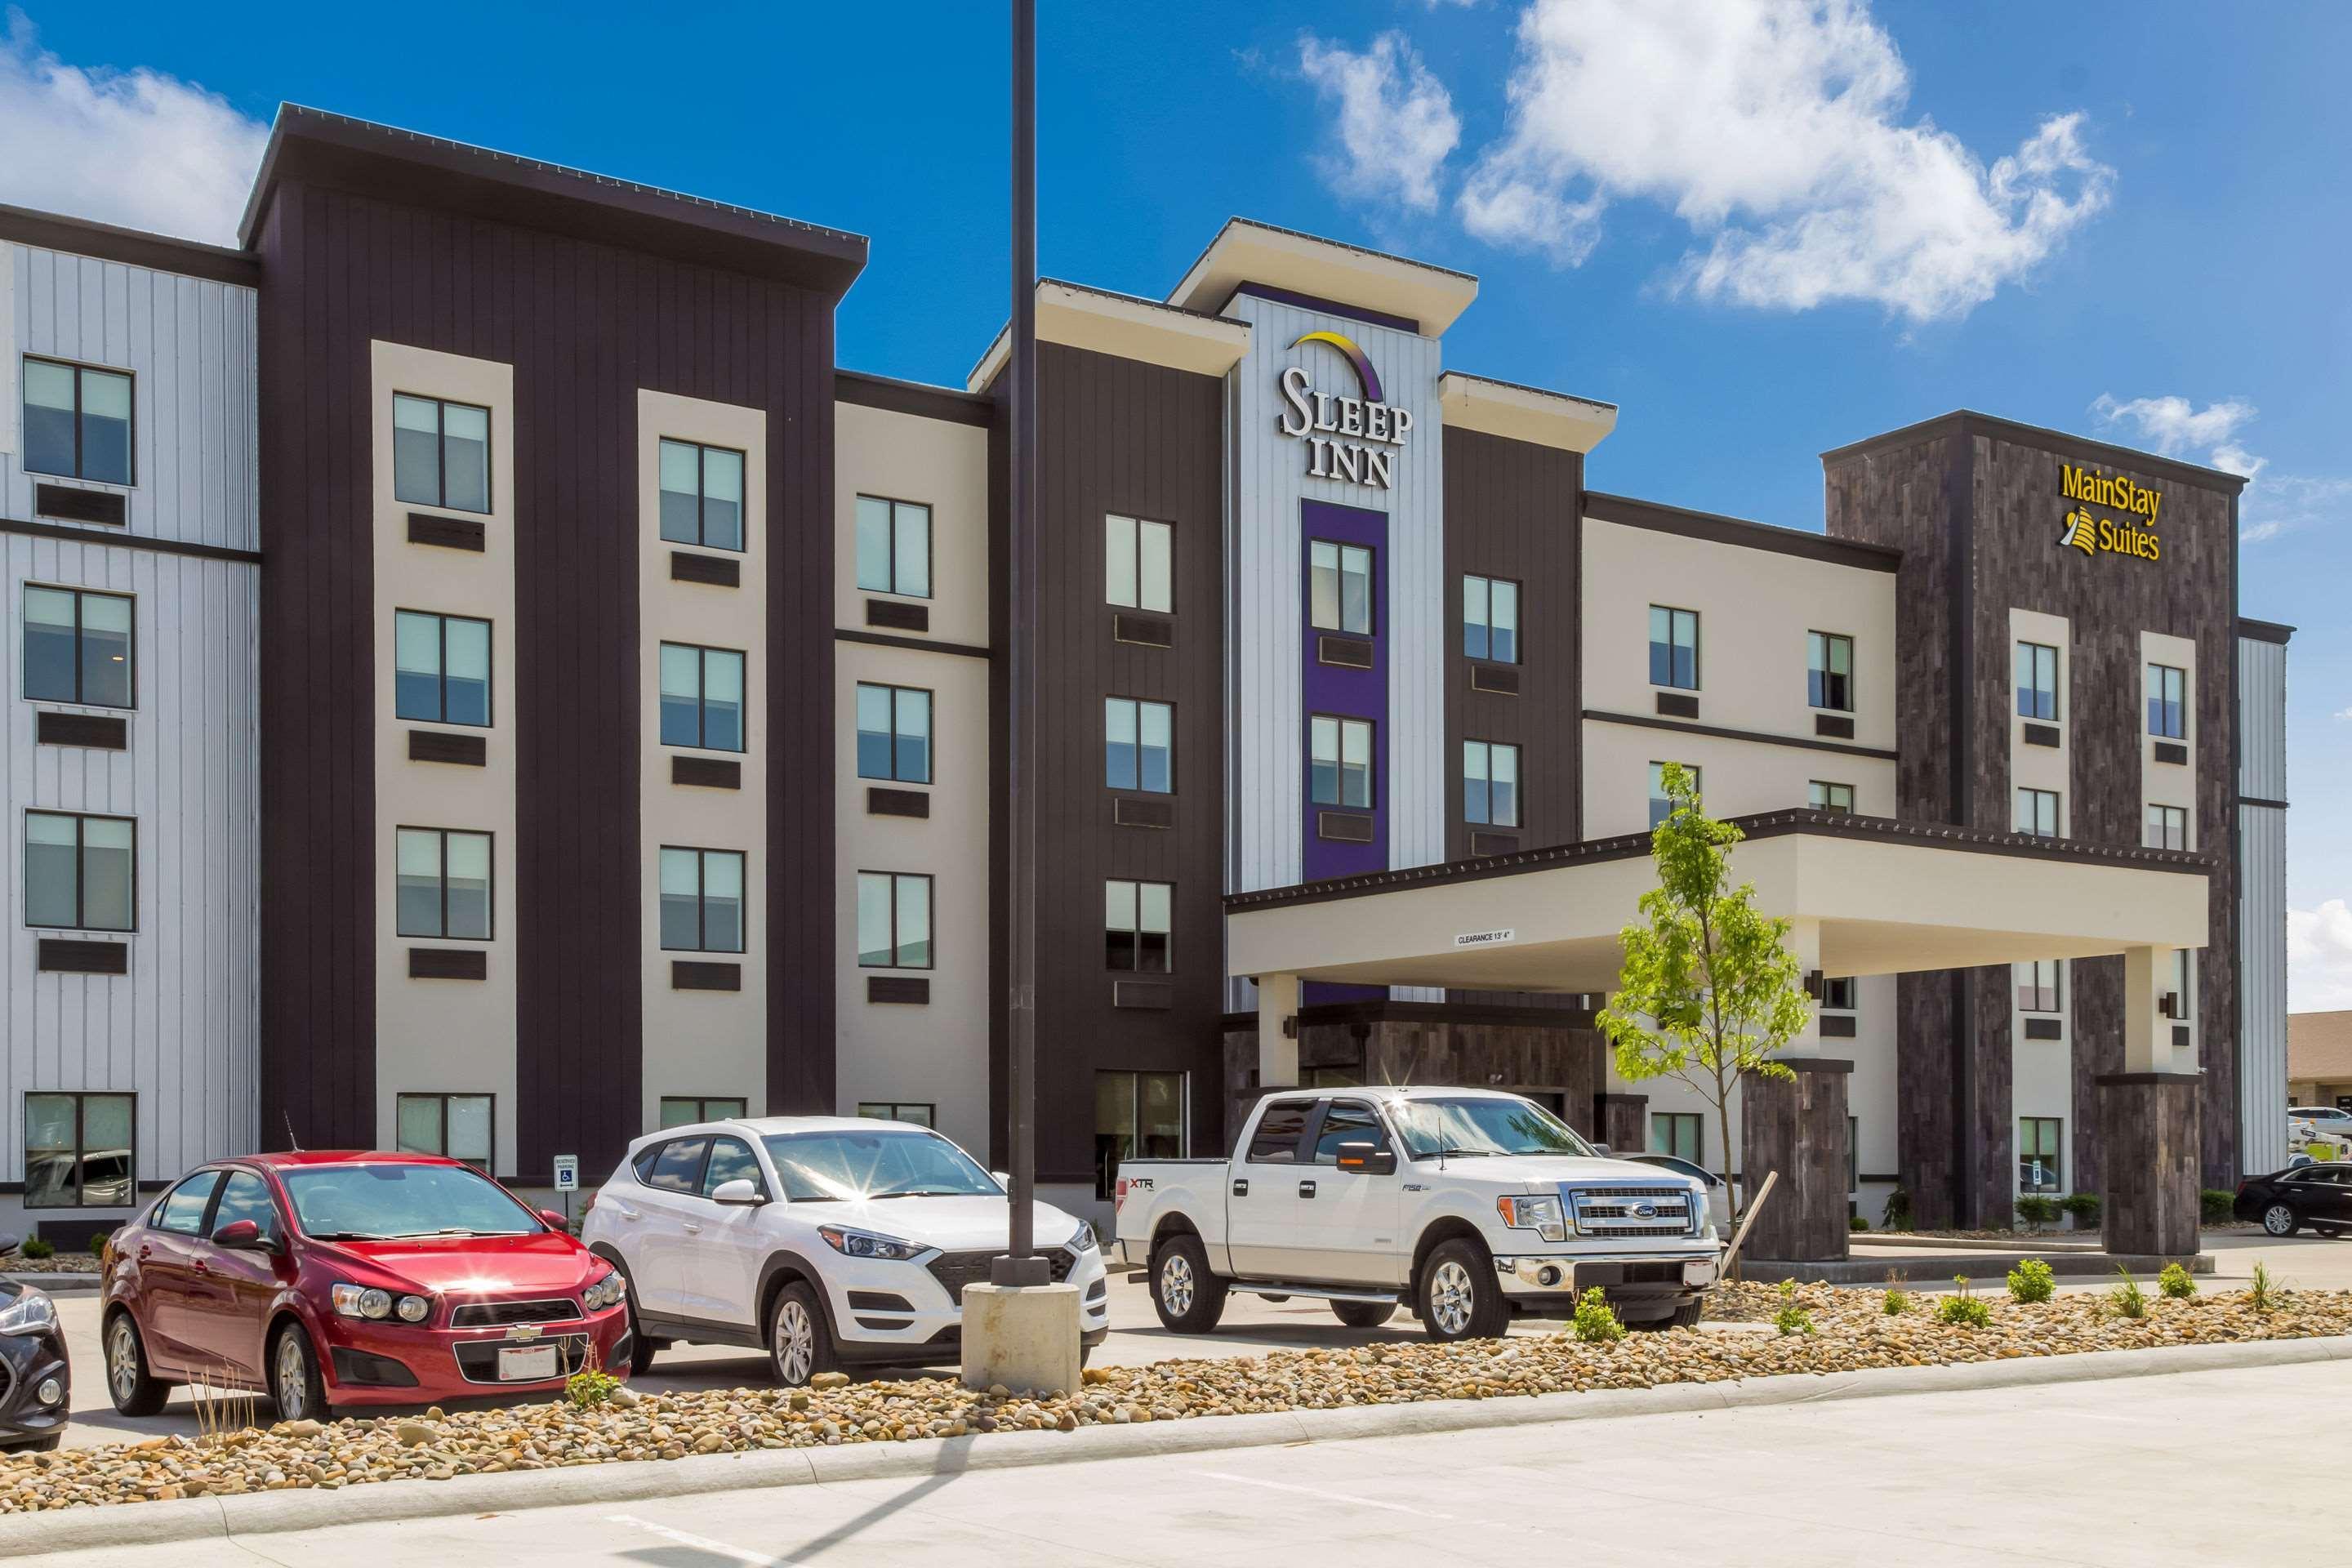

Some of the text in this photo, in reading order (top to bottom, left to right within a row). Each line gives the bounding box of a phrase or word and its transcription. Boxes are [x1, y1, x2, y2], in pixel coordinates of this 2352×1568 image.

[1280, 367, 1414, 445] SLEEP
[1309, 437, 1396, 490] INN
[2062, 464, 2162, 527] MainStay
[2099, 518, 2159, 561] Suites
[1458, 933, 1493, 944] CLEARANCE
[1129, 1178, 1153, 1188] XTR
